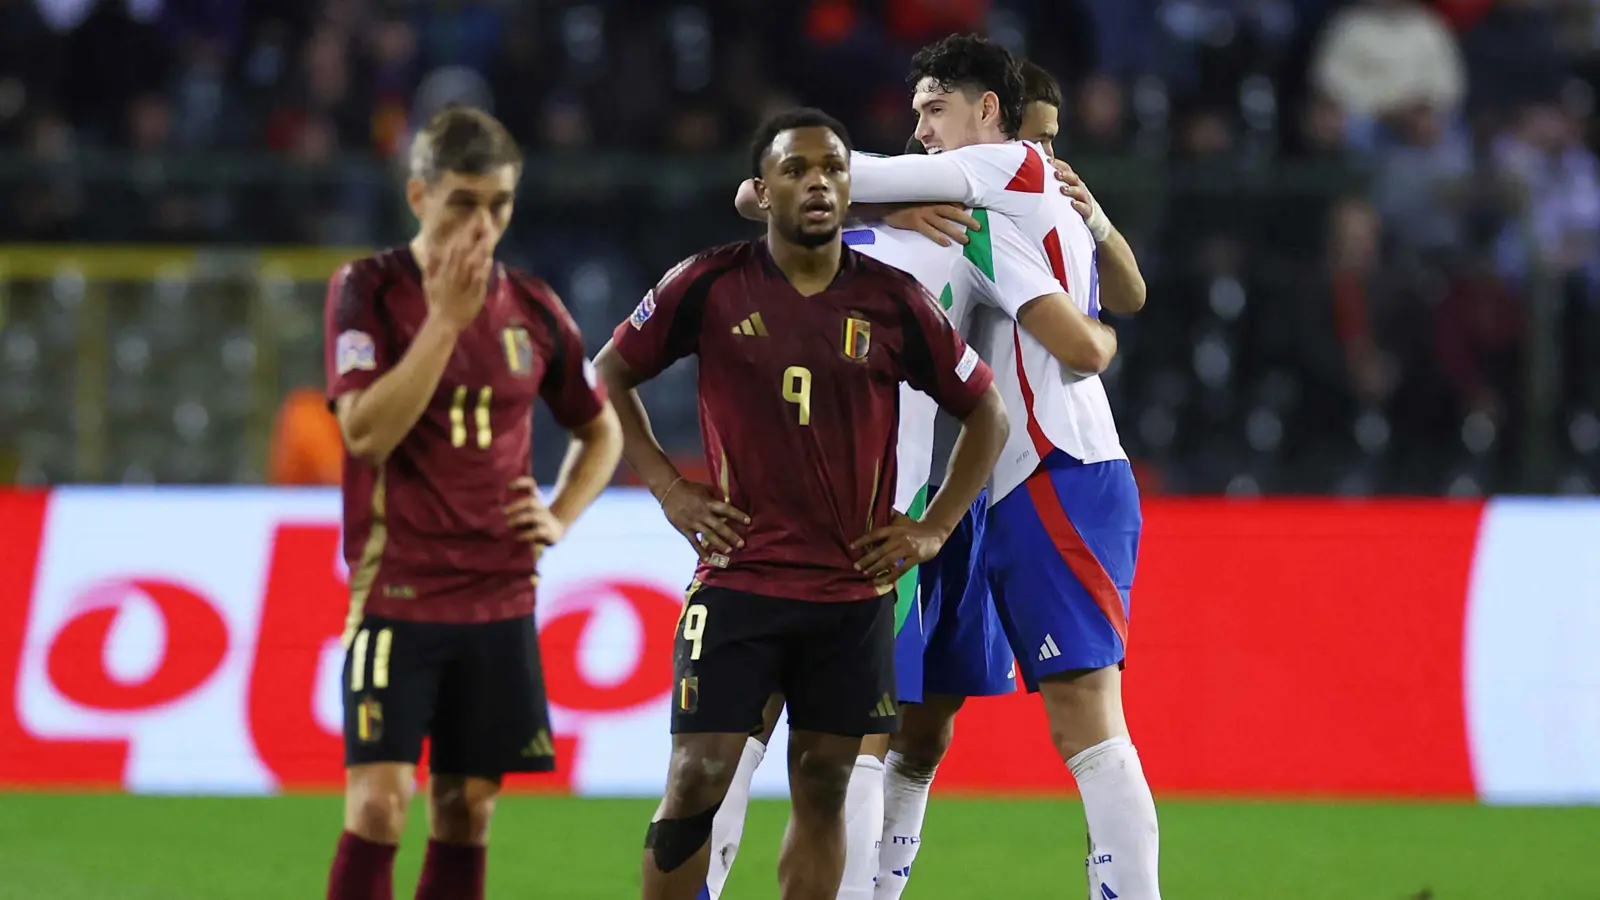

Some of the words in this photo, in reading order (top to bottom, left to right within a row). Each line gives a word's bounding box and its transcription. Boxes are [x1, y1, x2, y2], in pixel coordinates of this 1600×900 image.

[449, 385, 493, 449] 11
[782, 366, 811, 425] 9
[351, 628, 393, 692] 11
[683, 604, 708, 660] 9
